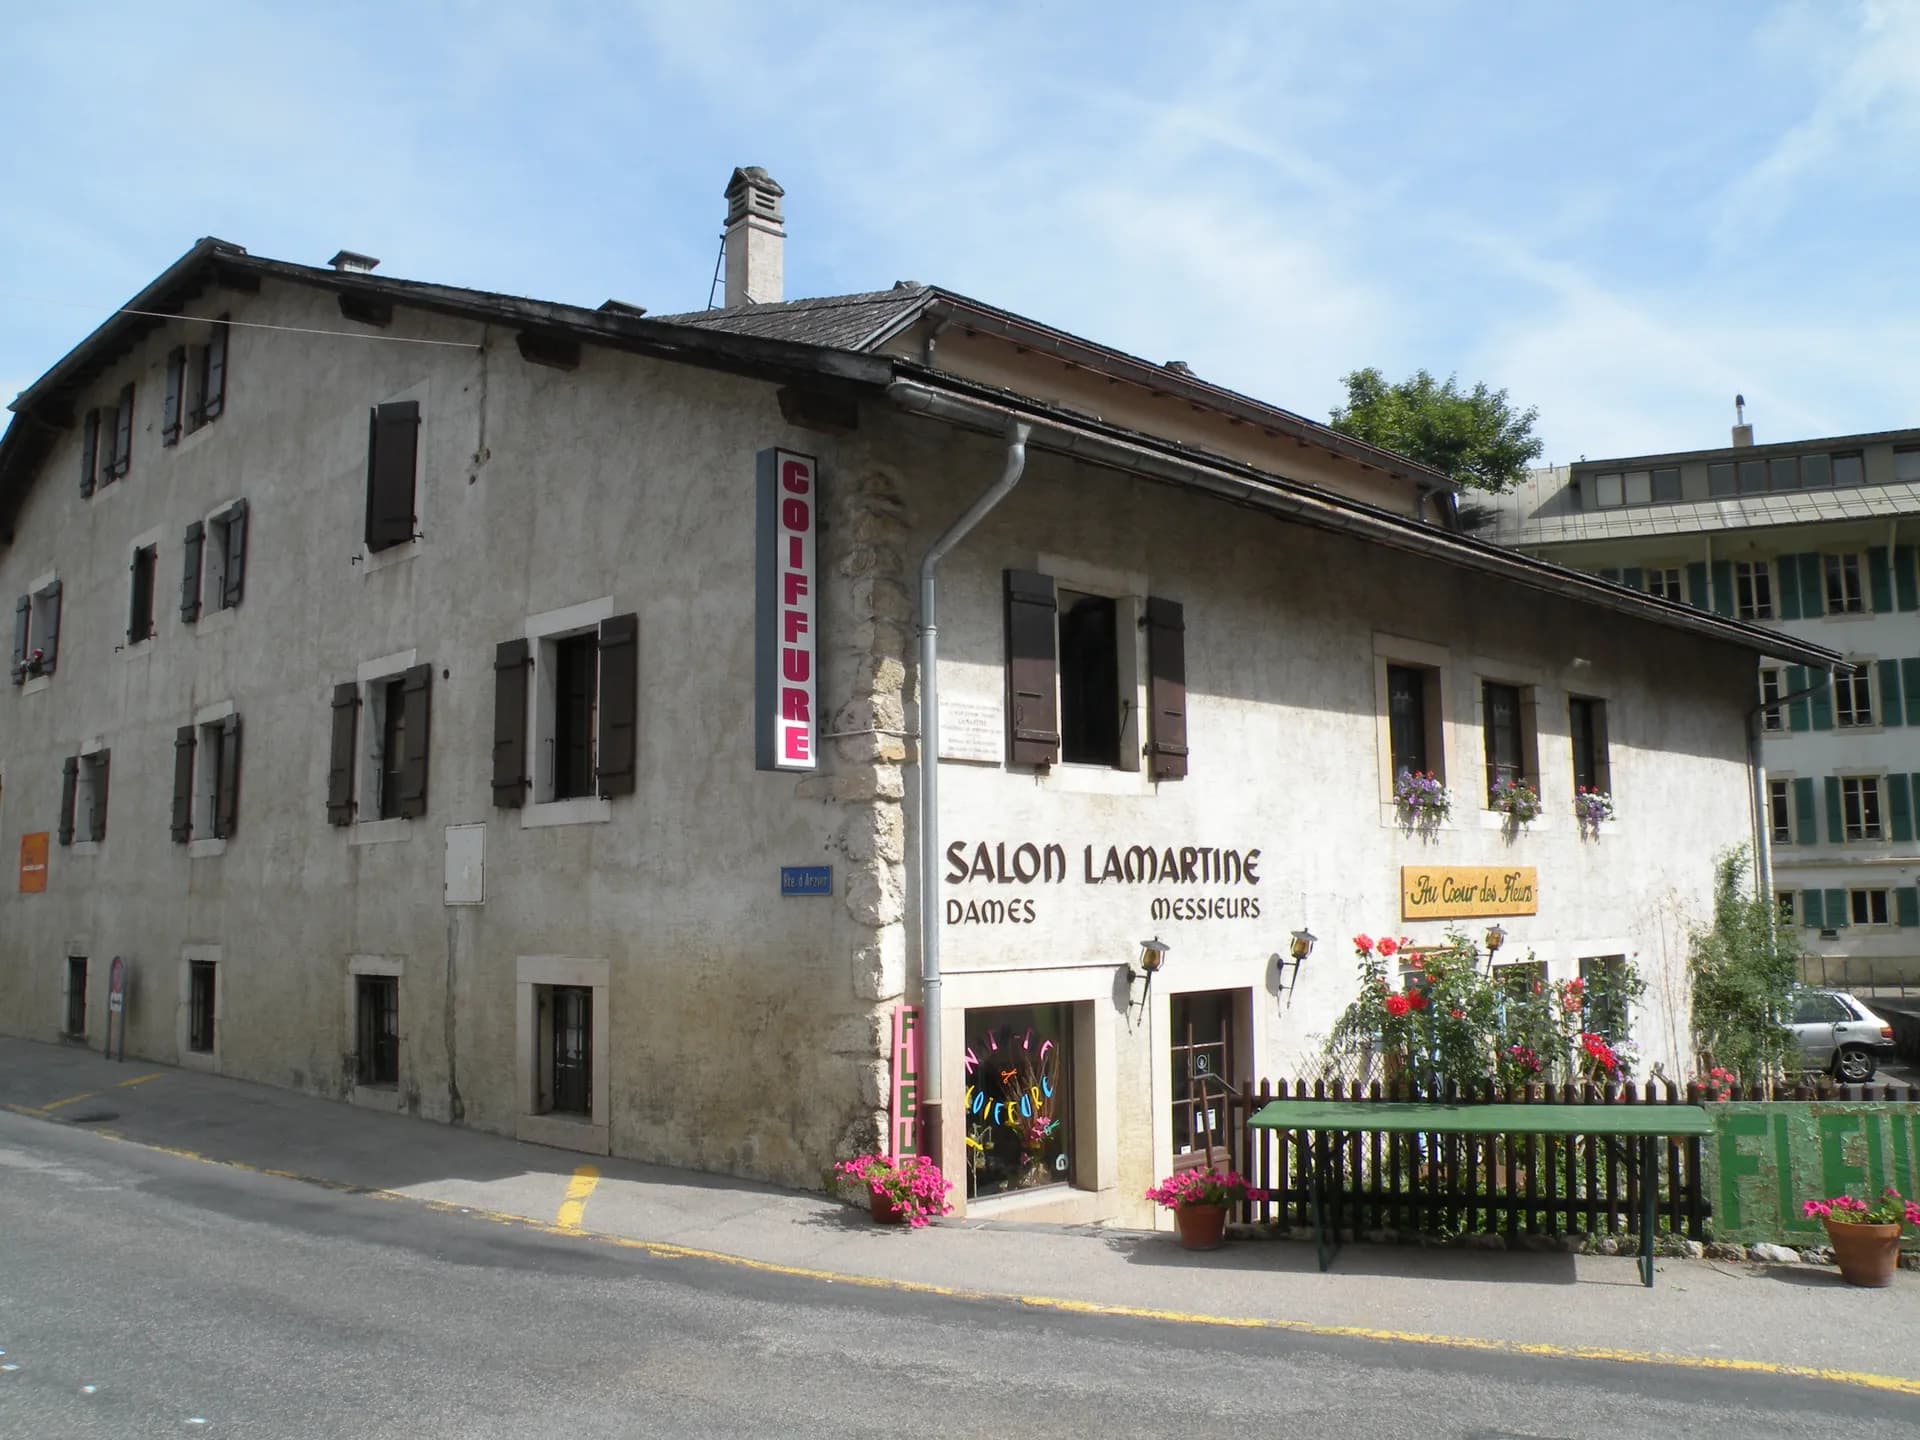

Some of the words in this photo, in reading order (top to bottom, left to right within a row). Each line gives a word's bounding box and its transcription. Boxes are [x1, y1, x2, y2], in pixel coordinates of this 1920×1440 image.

[781, 459, 811, 761] COIFFURE
[944, 840, 1066, 885] SALON
[1083, 844, 1262, 885] LAMARTINE
[1410, 875, 1439, 904] Au
[1480, 875, 1497, 902] des
[1498, 871, 1533, 902] Fleurs
[946, 898, 1037, 925] DAMES
[1150, 897, 1261, 921] MESSIEURS
[1716, 1113, 1920, 1232] FLEU
